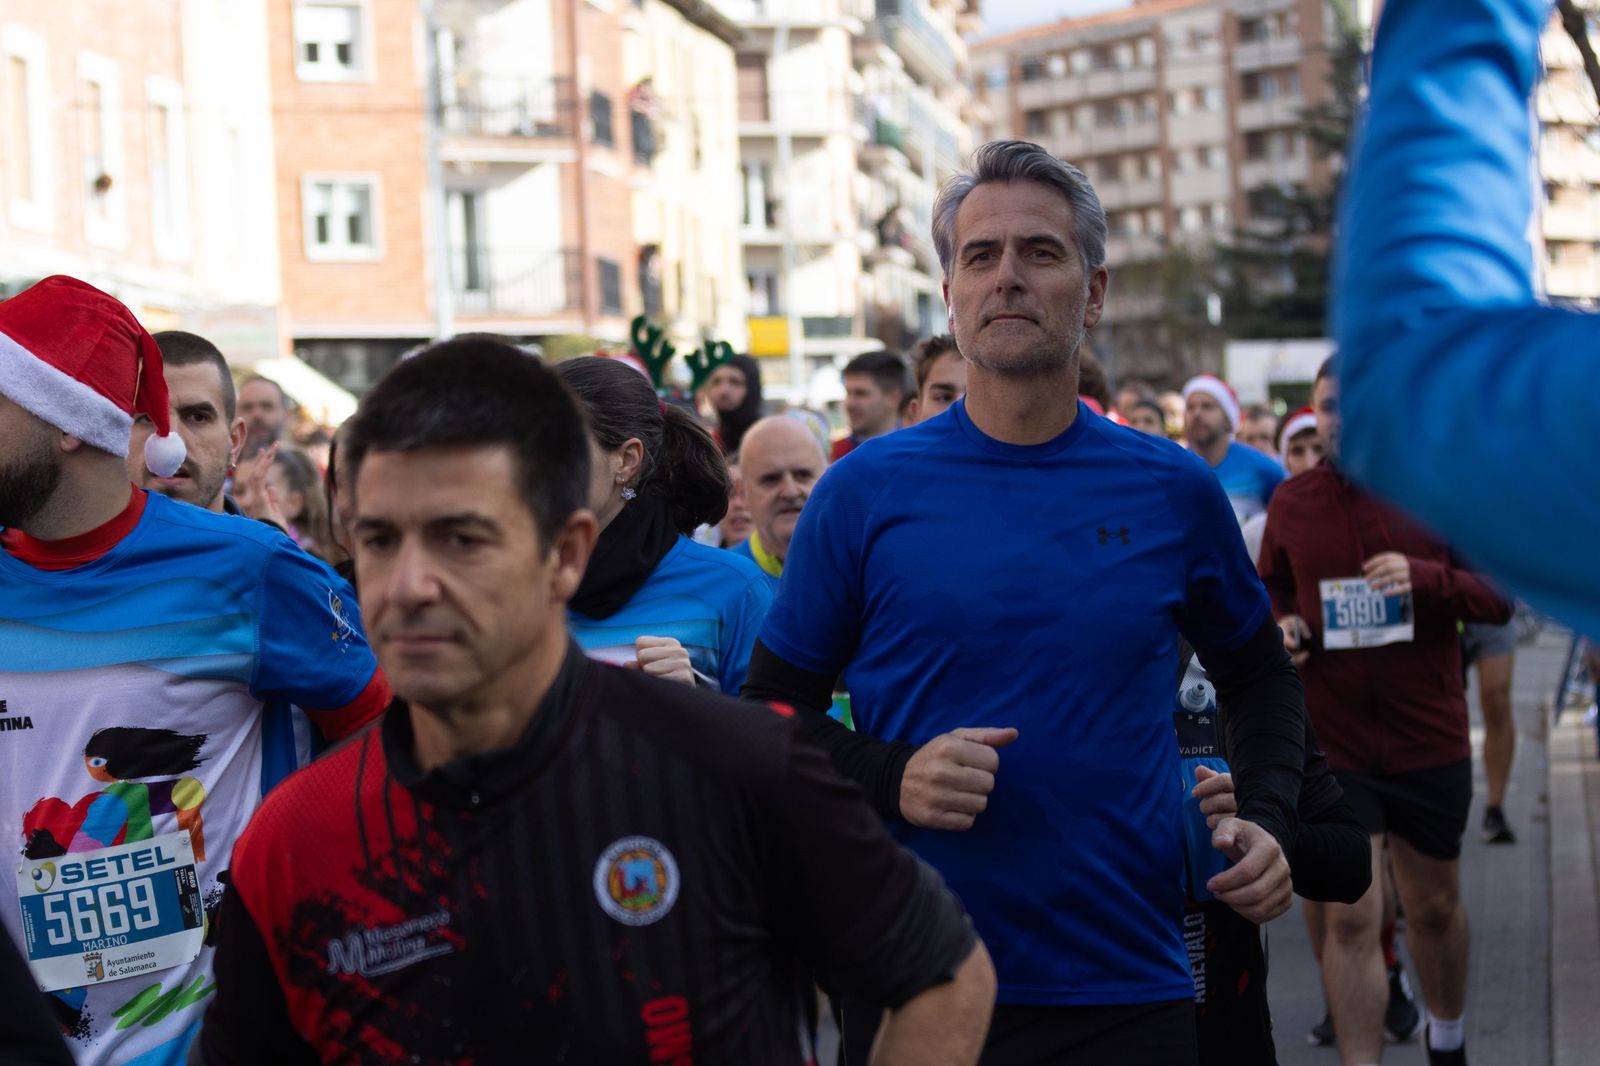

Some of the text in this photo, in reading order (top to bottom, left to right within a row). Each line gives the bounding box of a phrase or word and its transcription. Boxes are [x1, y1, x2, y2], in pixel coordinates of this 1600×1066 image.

[1335, 597, 1387, 626] 5190
[61, 846, 175, 884] SETEL
[43, 877, 160, 946] 5669
[83, 935, 128, 952] MARINO
[107, 951, 156, 968] Ayuntamiento
[108, 961, 157, 978] de Salamanca
